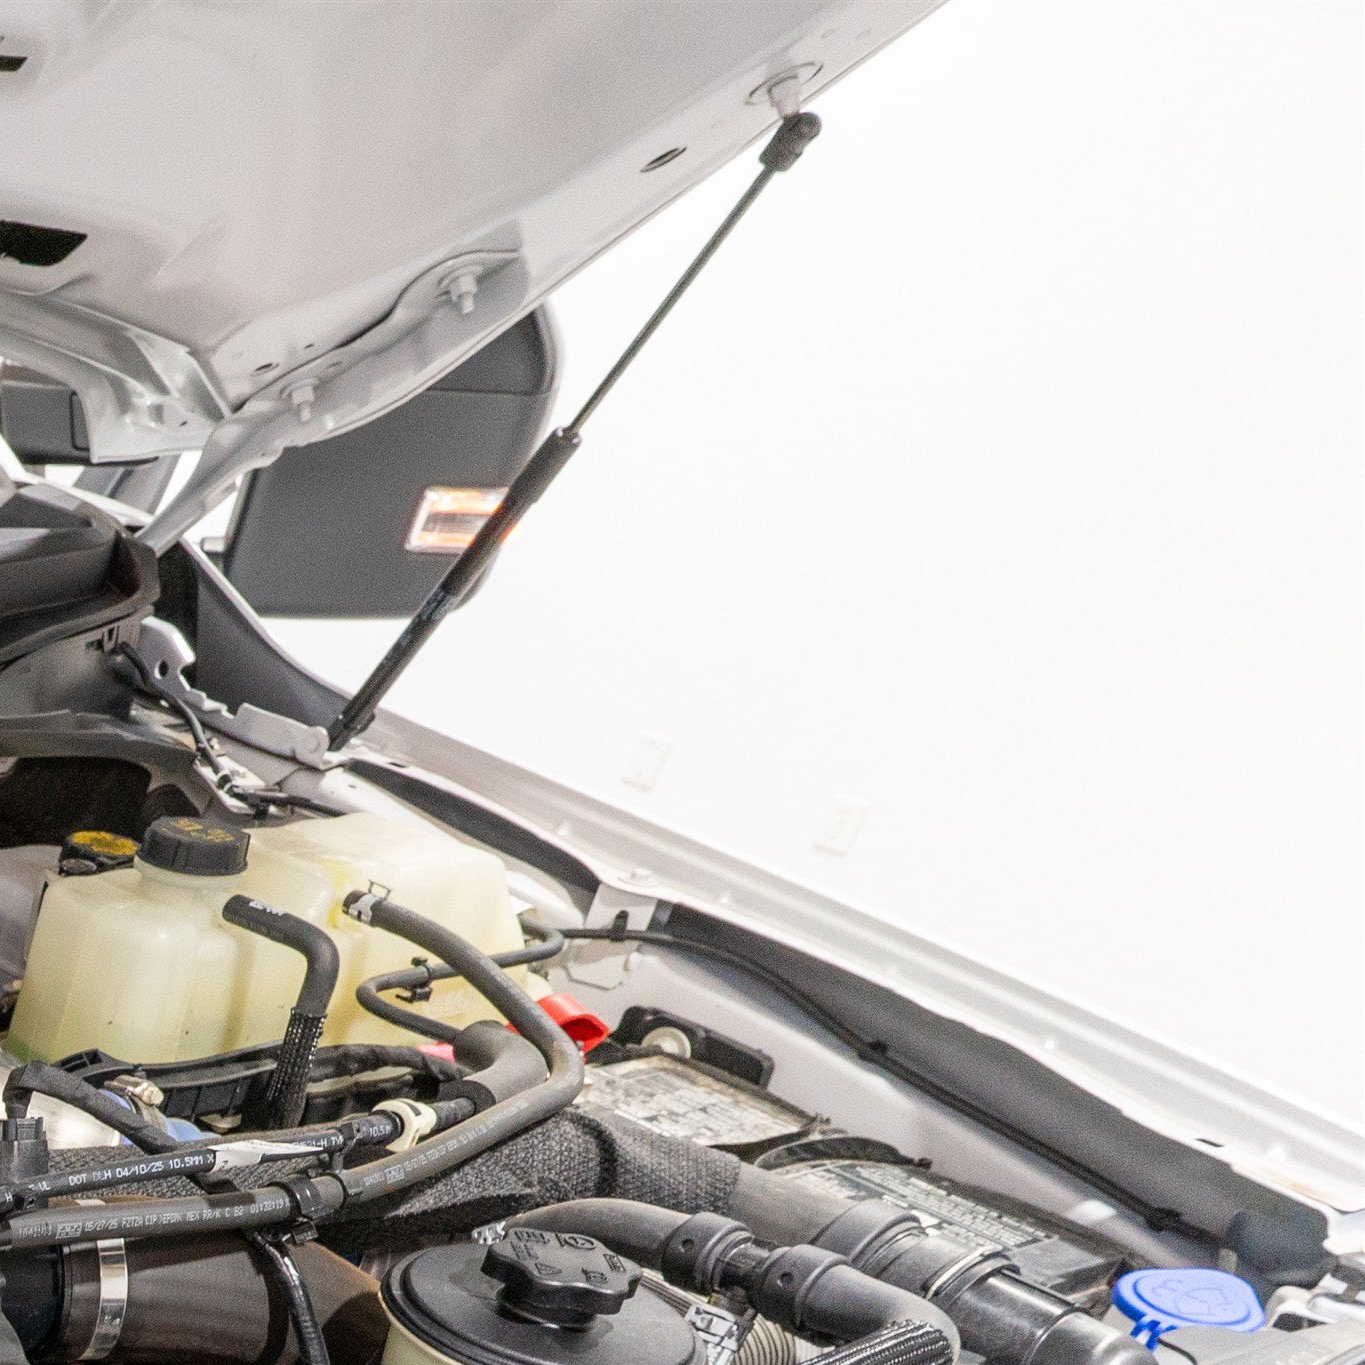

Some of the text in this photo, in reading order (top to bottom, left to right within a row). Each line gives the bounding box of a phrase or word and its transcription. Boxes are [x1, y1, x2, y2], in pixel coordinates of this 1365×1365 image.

[69, 1174, 87, 1187] DOT
[116, 1161, 164, 1179] 04/10/25
[169, 1153, 203, 1171] 10.5MM
